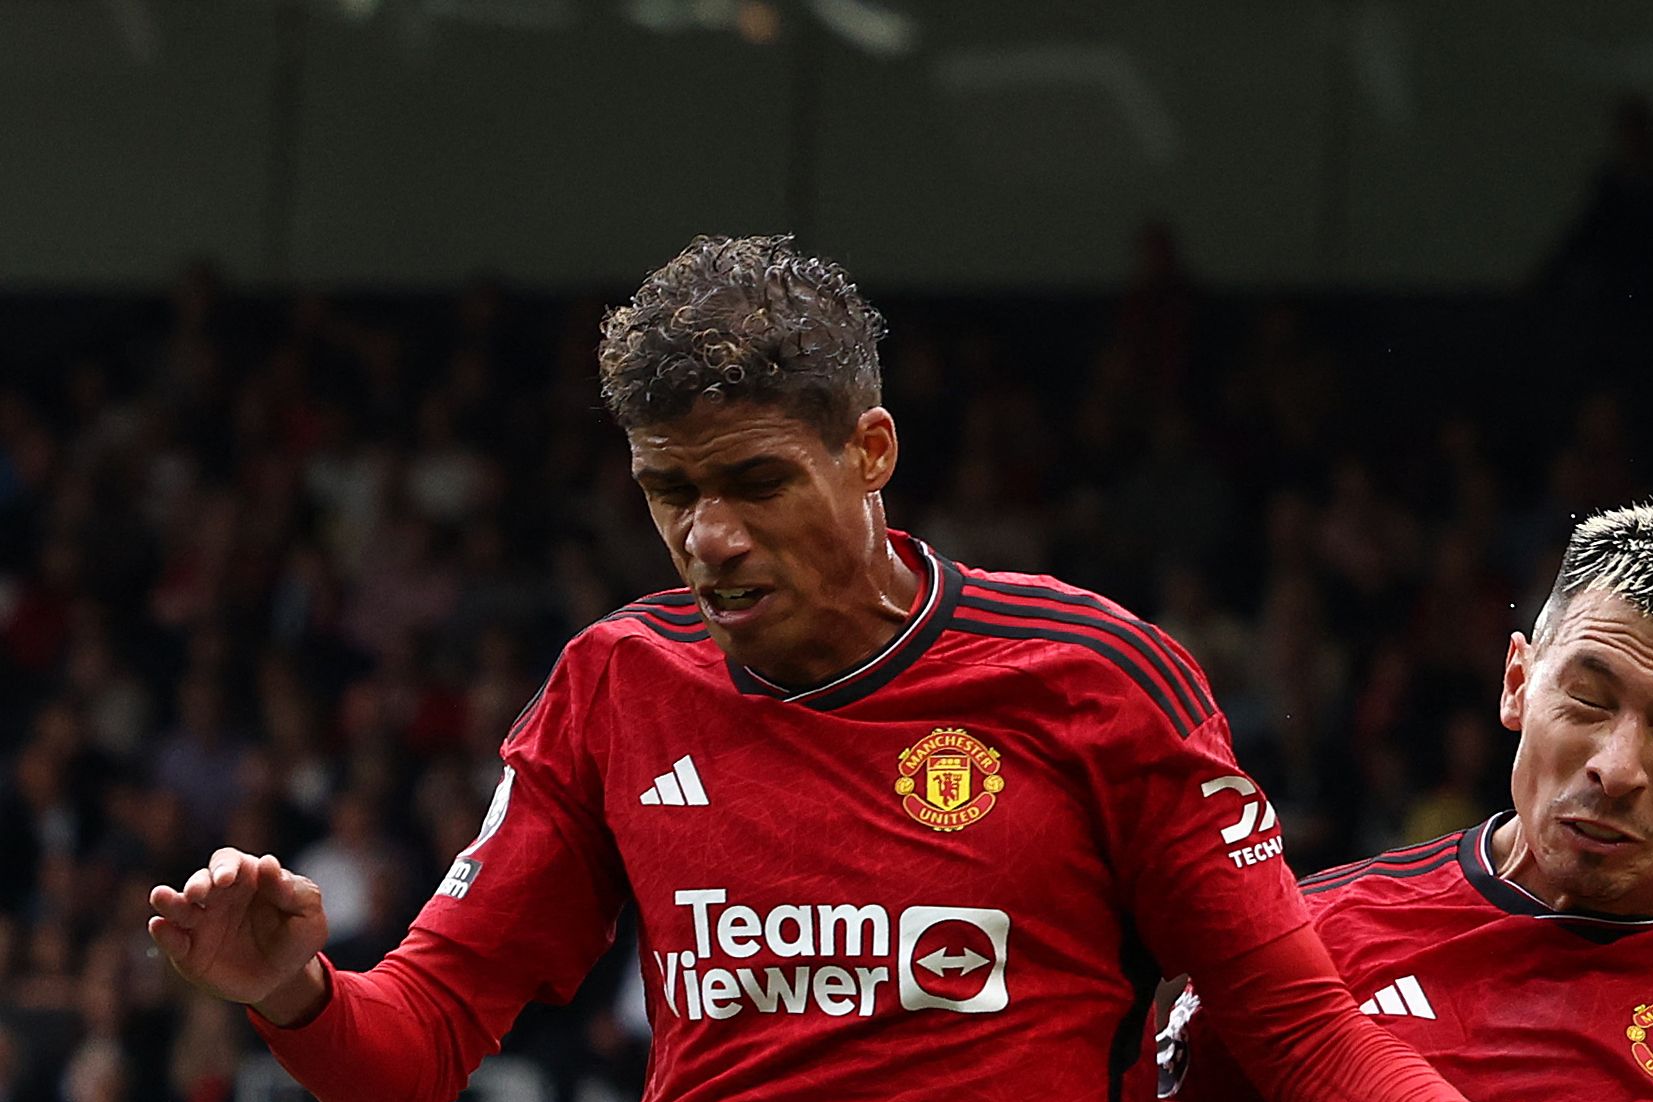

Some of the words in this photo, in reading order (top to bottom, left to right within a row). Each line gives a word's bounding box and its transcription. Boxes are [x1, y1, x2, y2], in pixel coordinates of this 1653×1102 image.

[905, 735, 993, 769] MANCHESTER
[919, 806, 981, 825] UNITED
[674, 888, 890, 959] Team
[653, 950, 890, 1021] Viewer
